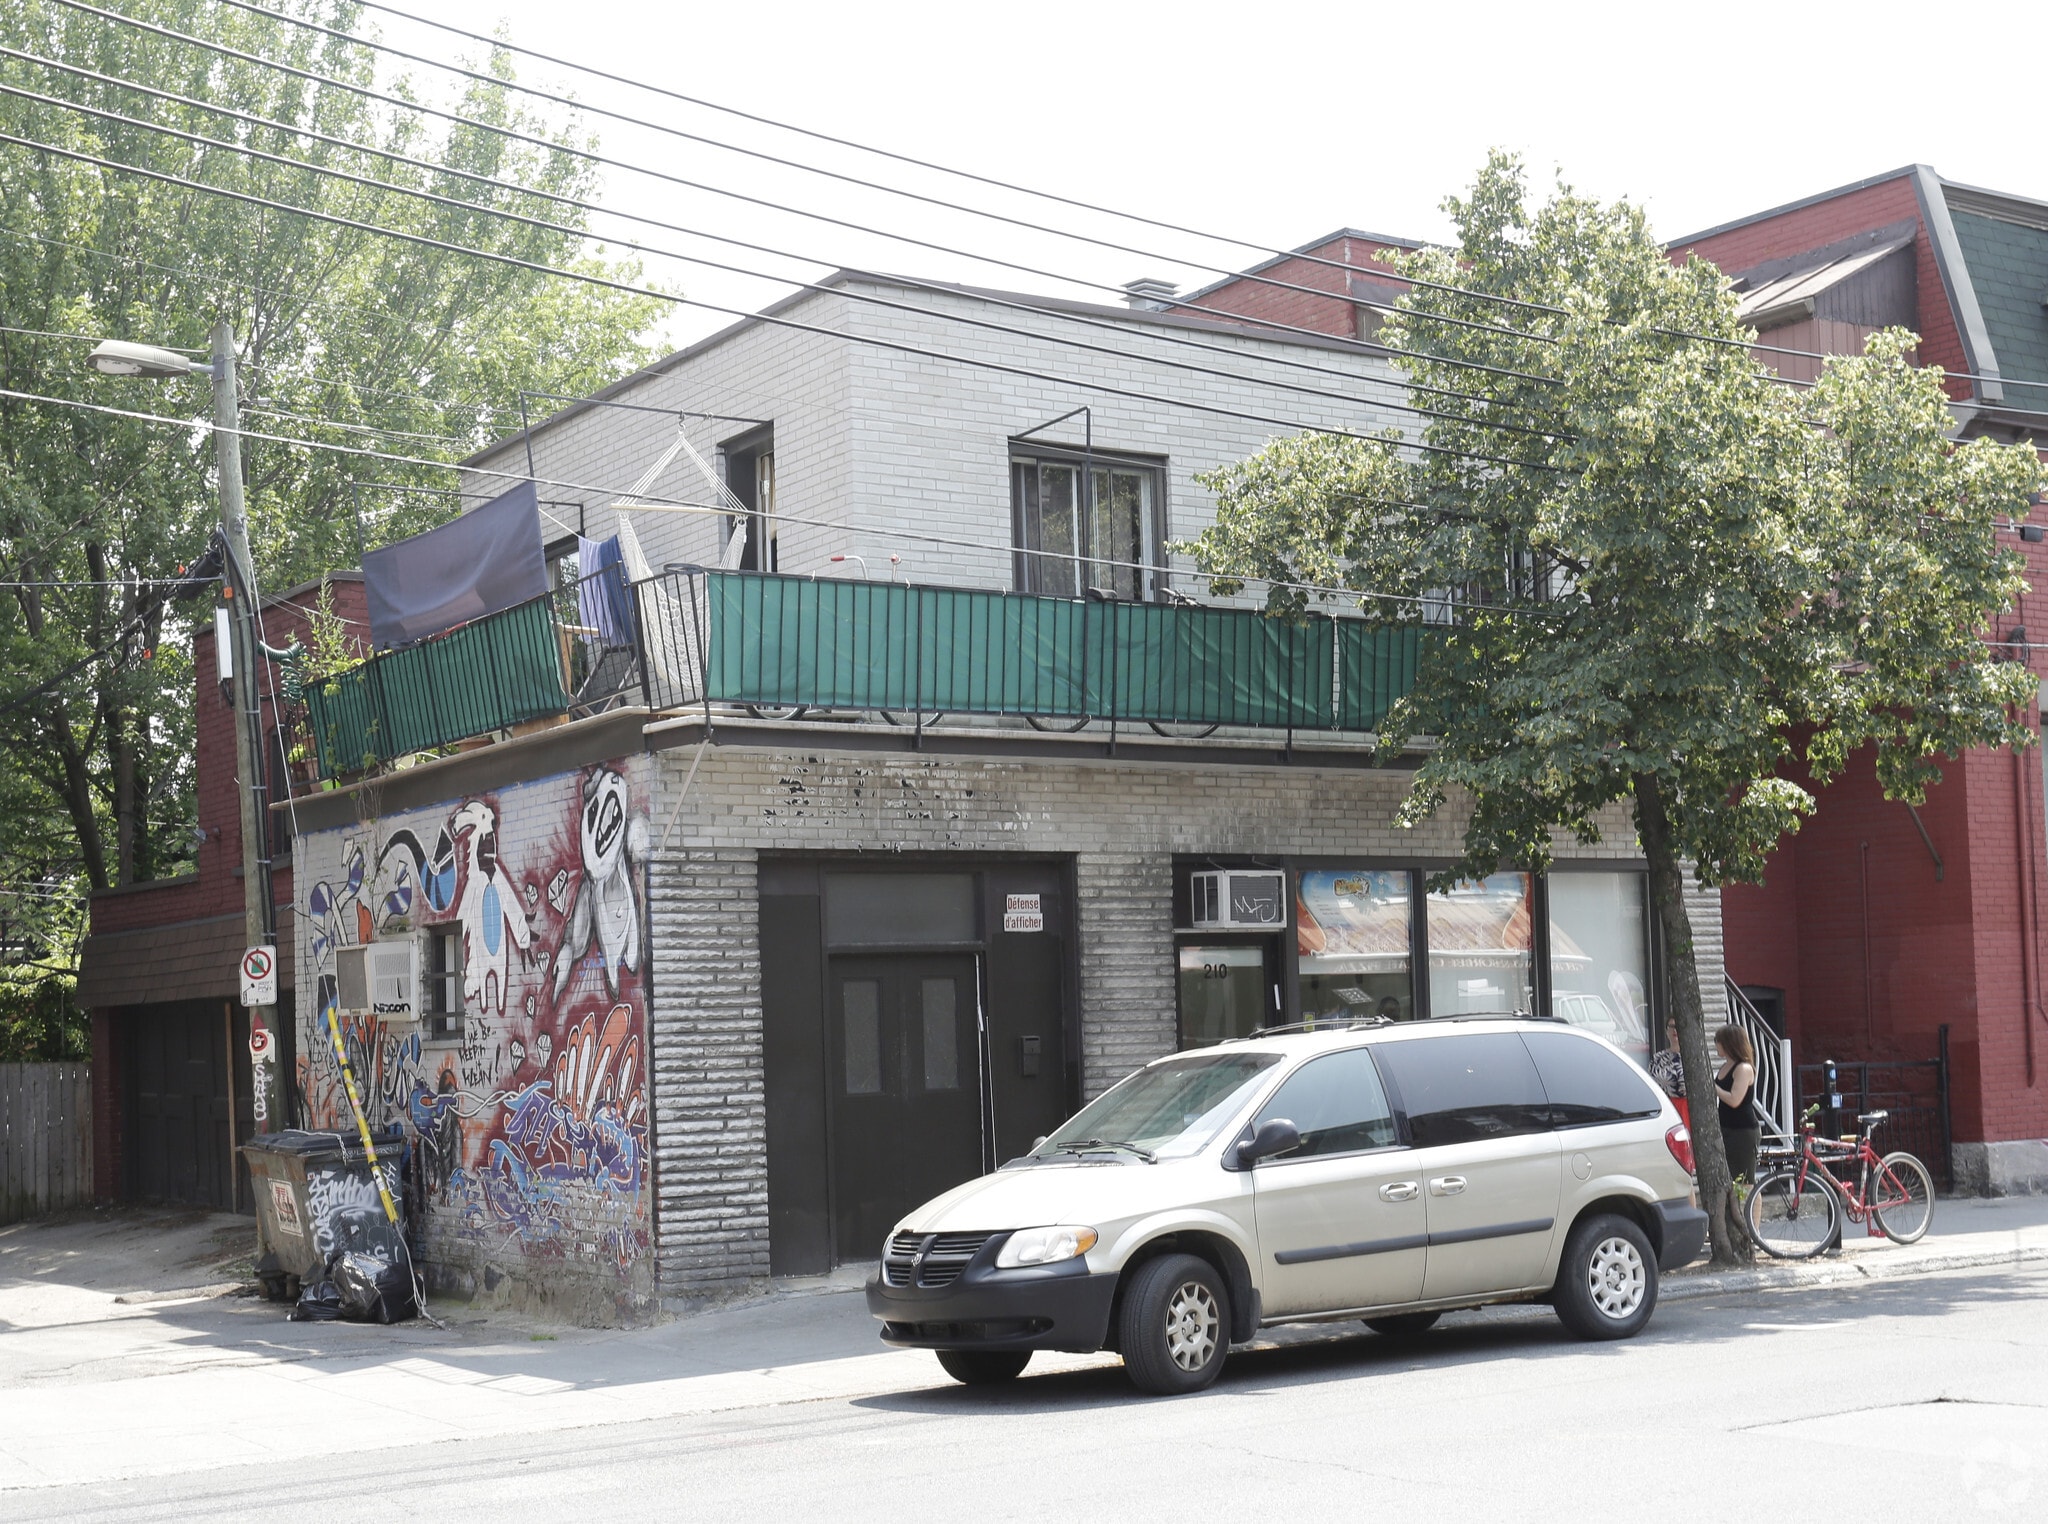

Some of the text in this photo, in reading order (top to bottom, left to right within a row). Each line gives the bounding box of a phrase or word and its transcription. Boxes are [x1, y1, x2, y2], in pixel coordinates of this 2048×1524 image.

[1007, 897, 1039, 910] Défense
[1005, 916, 1042, 929] d'afficher
[1203, 963, 1228, 979] 210
